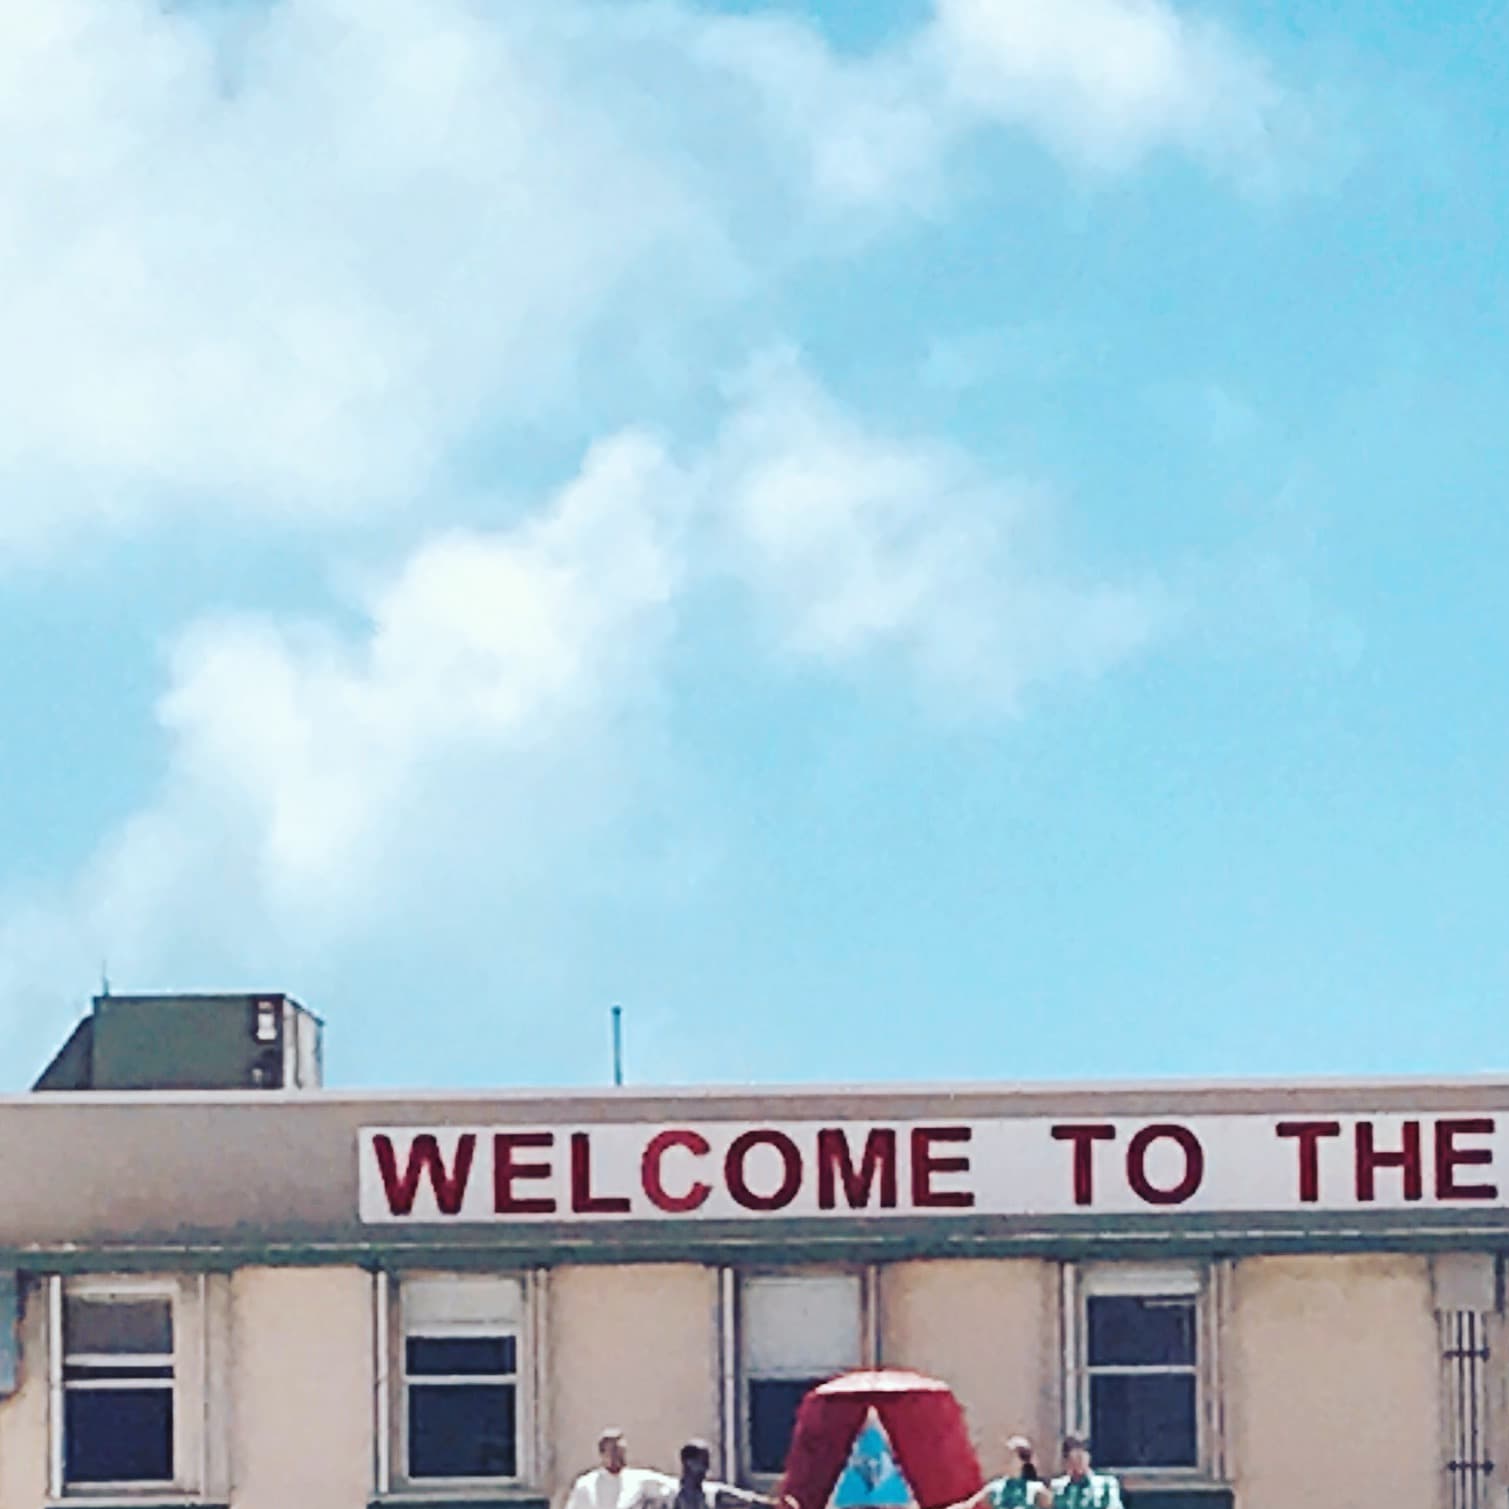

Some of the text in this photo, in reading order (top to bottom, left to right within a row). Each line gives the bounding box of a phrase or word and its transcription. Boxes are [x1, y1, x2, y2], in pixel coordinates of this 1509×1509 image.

[372, 1127, 974, 1215] WELCOME
[1051, 1123, 1203, 1206] TO
[1276, 1118, 1498, 1202] THE
